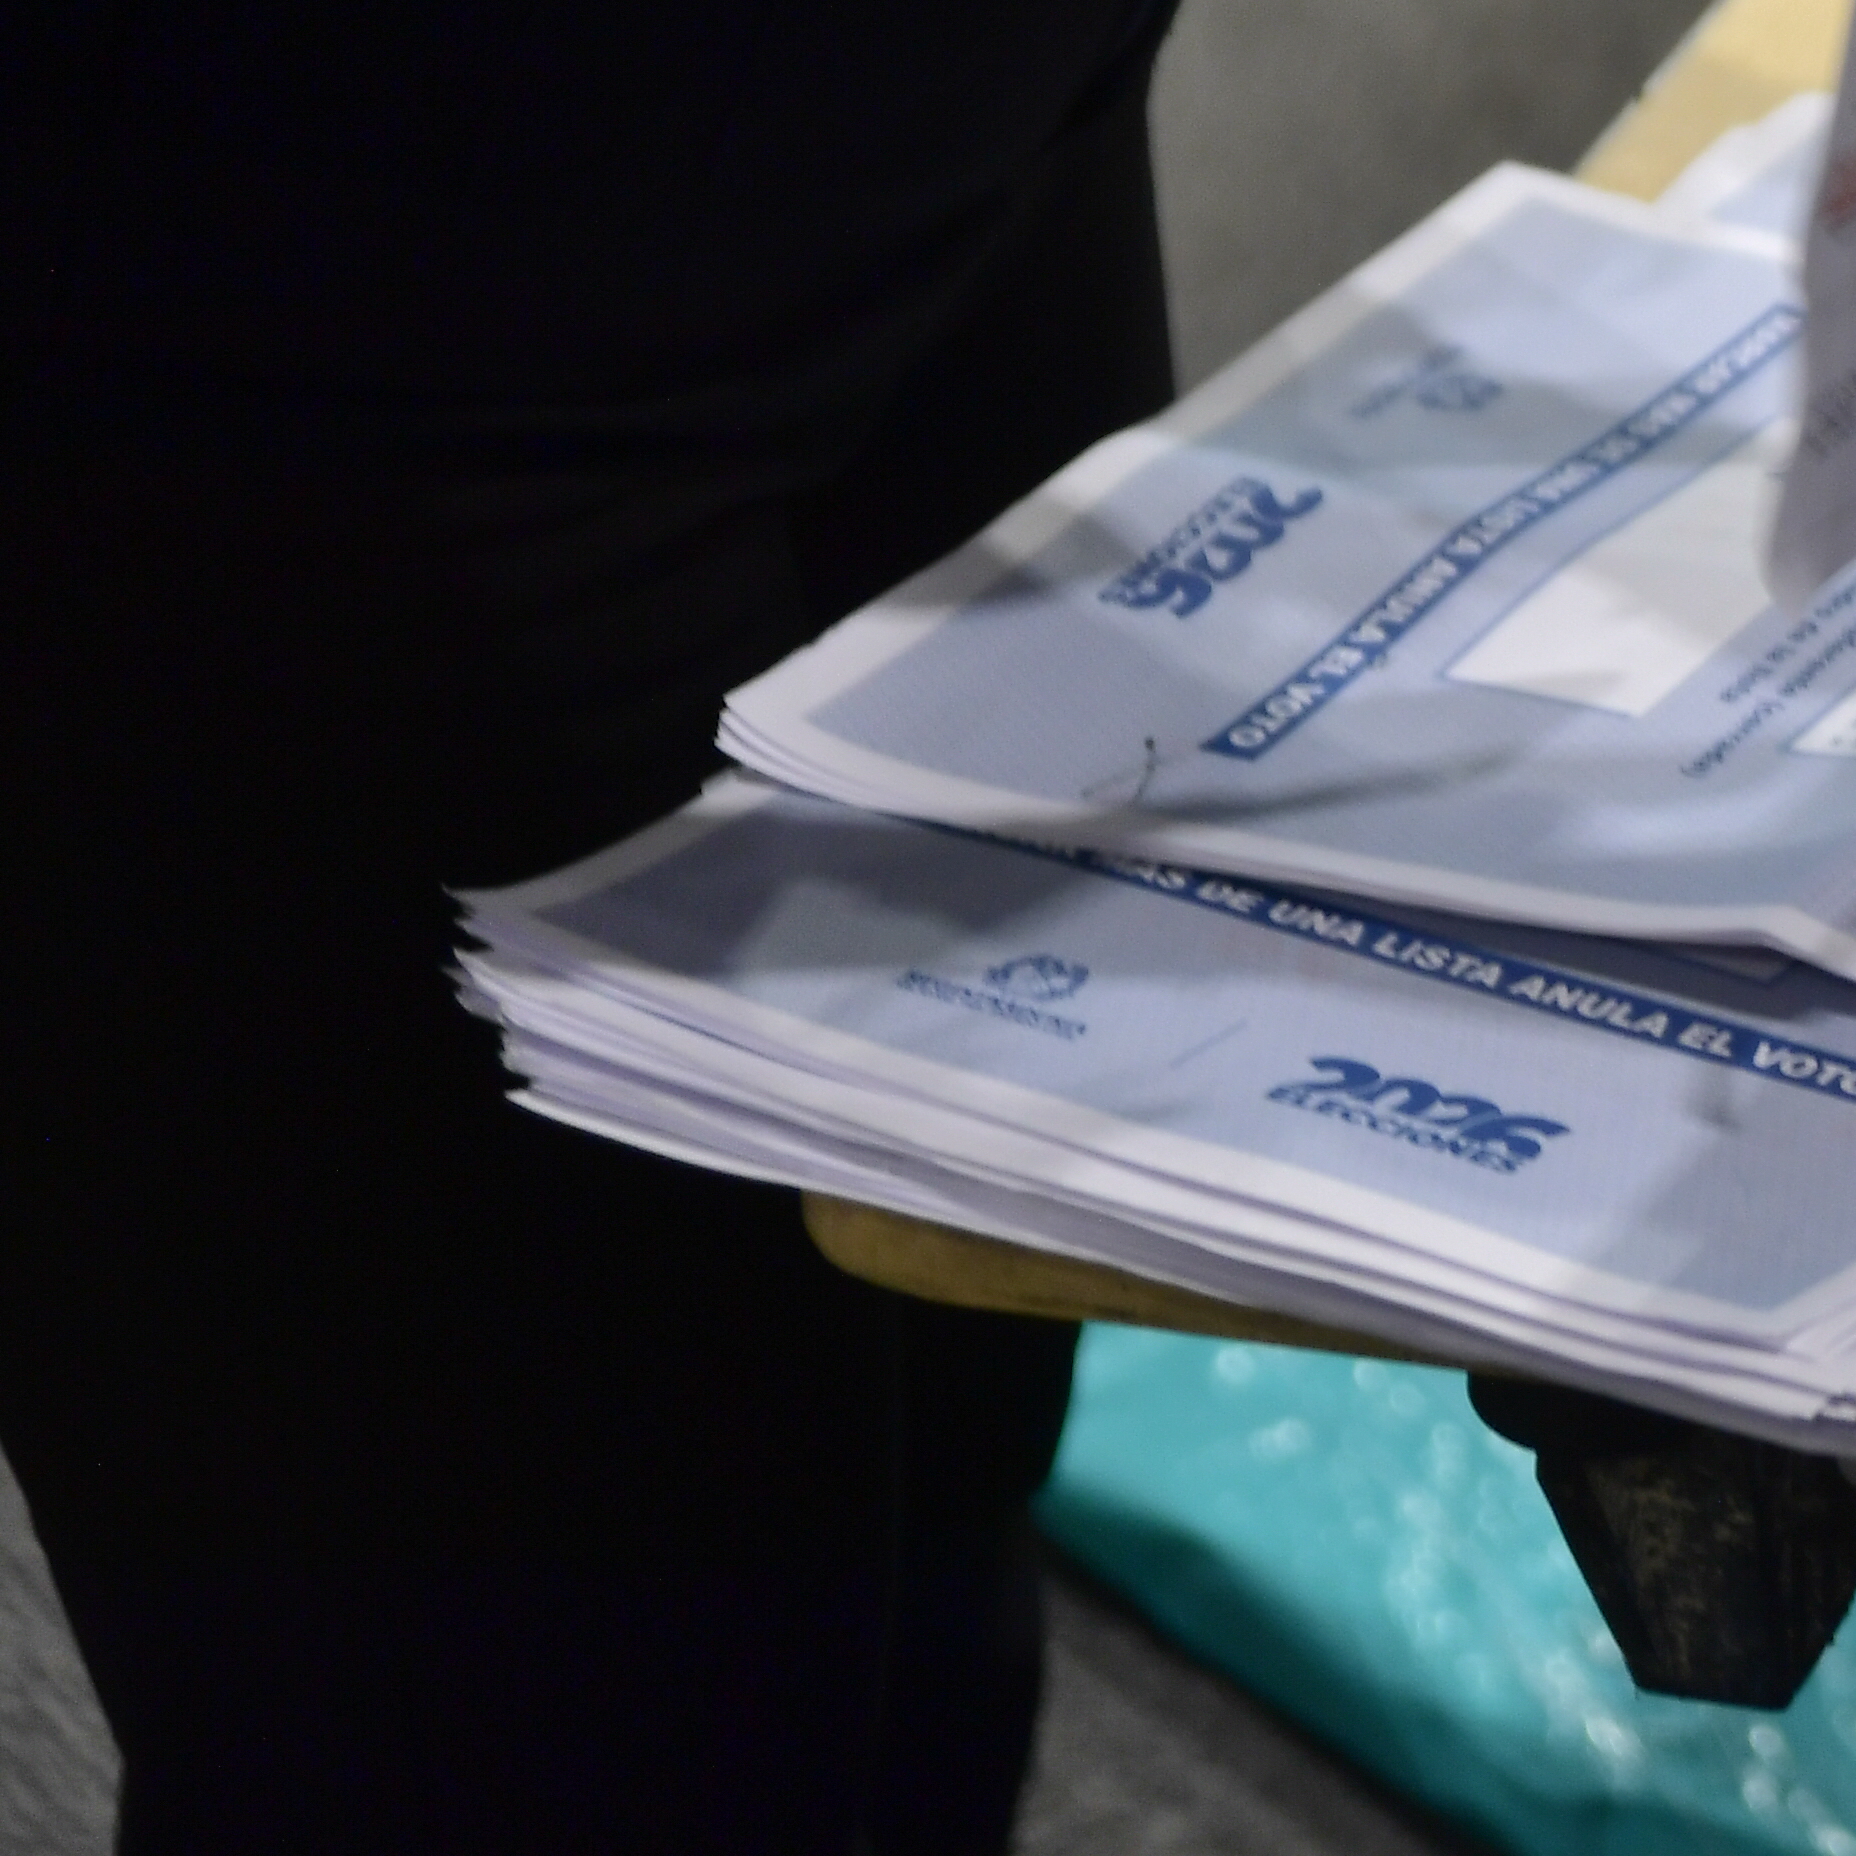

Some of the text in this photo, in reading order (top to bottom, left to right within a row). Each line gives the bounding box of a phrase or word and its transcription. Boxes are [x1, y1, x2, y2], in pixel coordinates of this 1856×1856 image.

[1118, 481, 1324, 619] 2026
[1348, 551, 1457, 656] ANULA
[1224, 672, 1322, 756] VOTO
[1307, 639, 1365, 691] EL
[1193, 872, 1261, 916] DE
[1266, 894, 1364, 948] UNA
[1371, 925, 1503, 992] LISTA
[1506, 965, 1669, 1042] ANULA
[1675, 1017, 1739, 1059] EL
[1302, 1058, 1573, 1161] 2026
